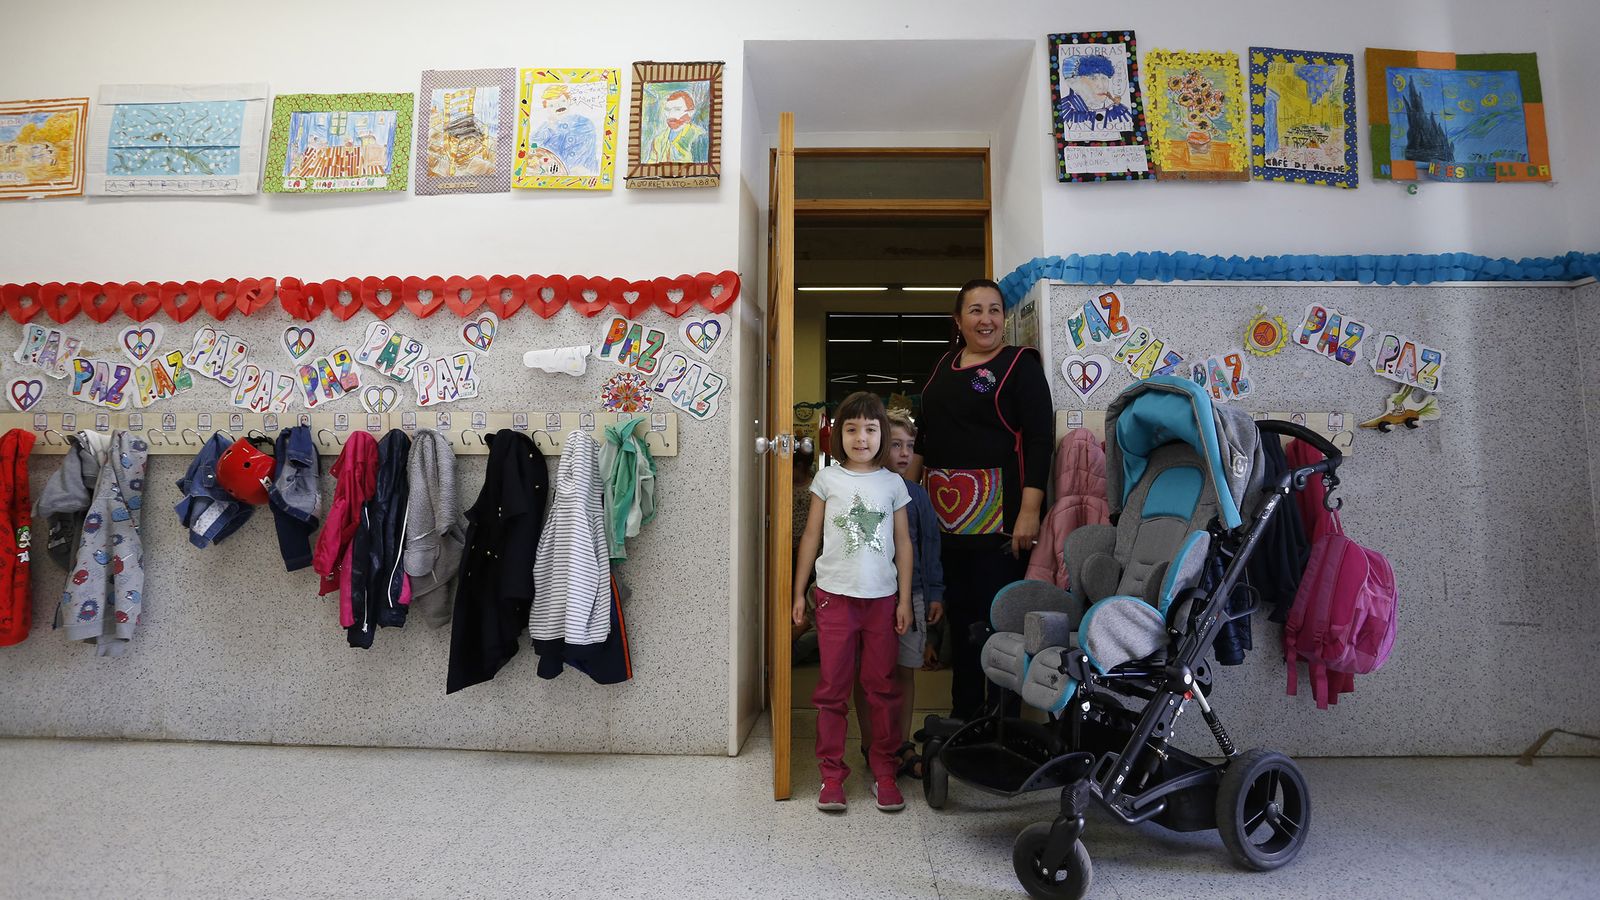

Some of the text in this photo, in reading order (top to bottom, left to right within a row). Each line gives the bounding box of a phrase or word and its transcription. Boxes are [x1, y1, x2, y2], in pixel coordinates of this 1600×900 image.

[1061, 46, 1123, 56] MIS OBRAS
[1265, 156, 1288, 167] CAFÉ
[600, 317, 666, 374] PAZ
[1067, 291, 1130, 350] PAZ
[1299, 305, 1366, 366] PAZ
[22, 325, 81, 374] PAZ
[188, 327, 248, 385] PAZ
[359, 323, 423, 382] PAZ
[416, 353, 476, 403] PAZ
[1113, 326, 1184, 379] PAZ
[1375, 334, 1441, 391] PAZ
[73, 358, 131, 406] PAZ
[135, 350, 194, 407] PAZ
[234, 365, 295, 413] PAZ
[300, 350, 360, 407] PAZ
[654, 354, 724, 418] PAZ
